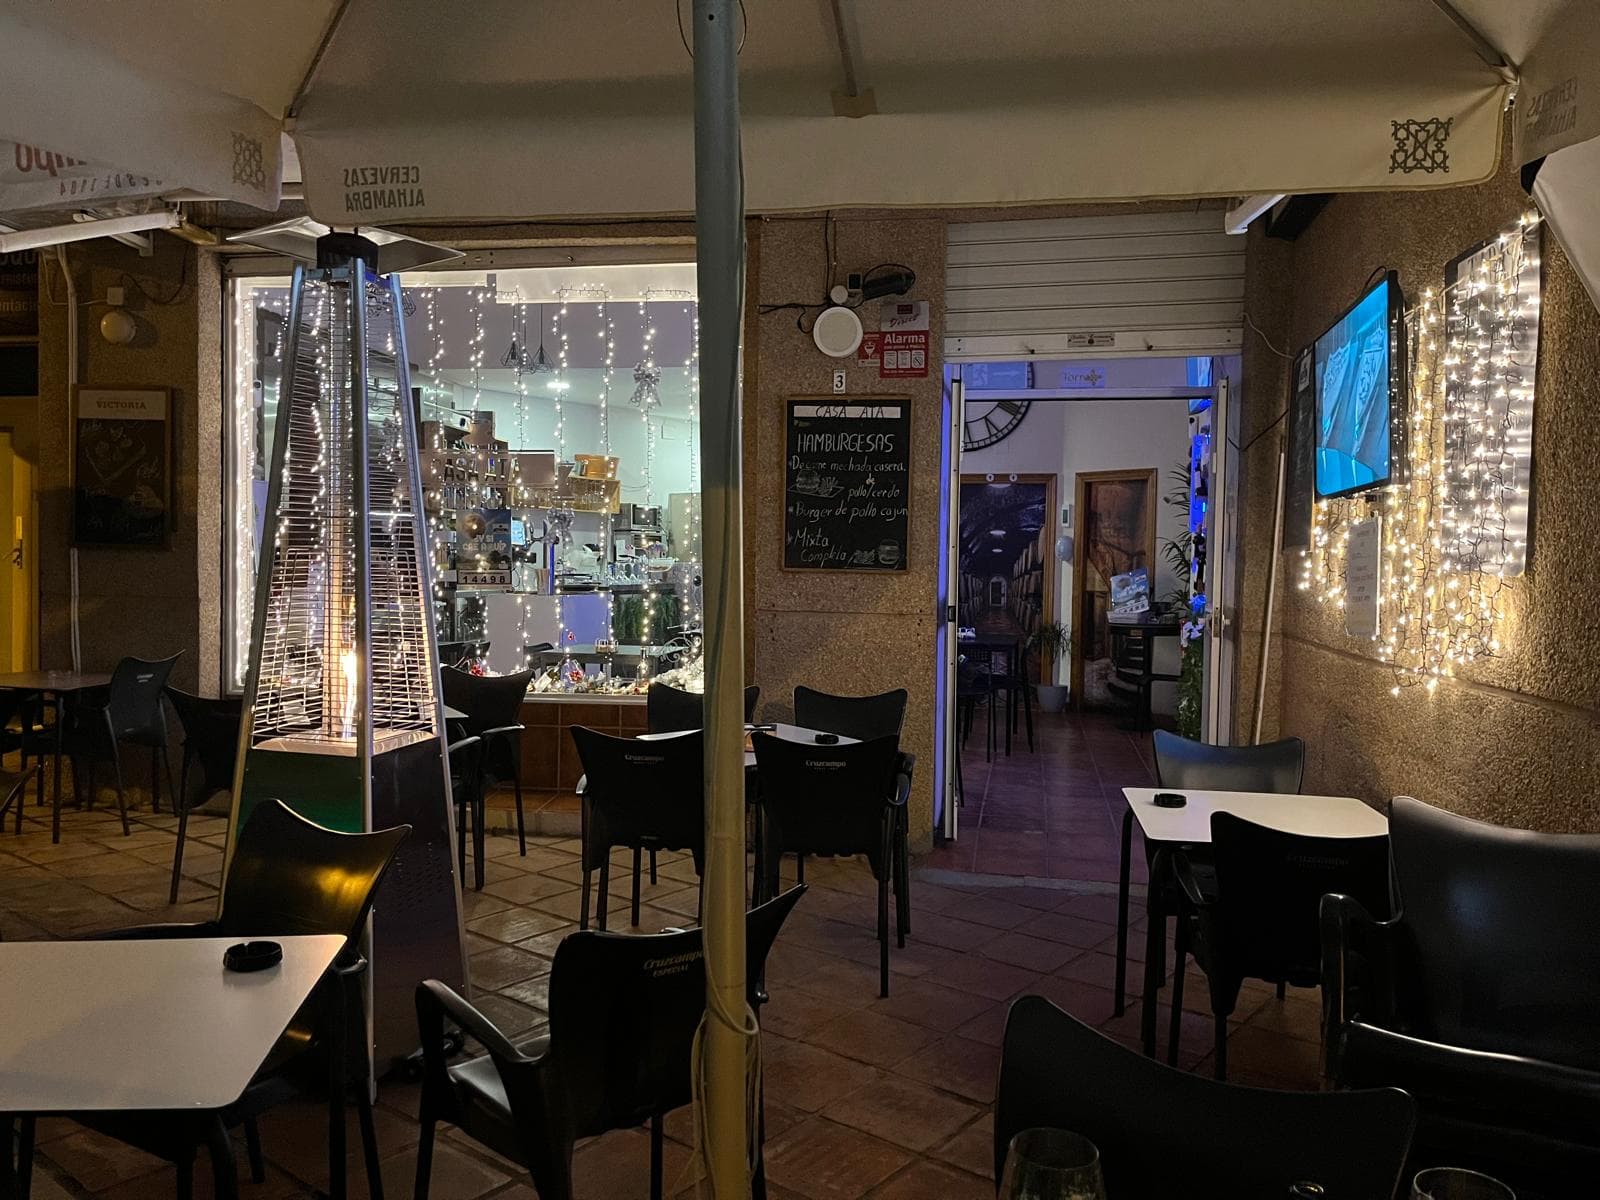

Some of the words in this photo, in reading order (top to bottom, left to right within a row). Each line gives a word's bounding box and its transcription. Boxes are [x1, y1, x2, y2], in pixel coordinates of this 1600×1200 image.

[884, 333, 925, 344] Alarma
[835, 374, 843, 388] 3
[96, 400, 147, 409] VICTORIA
[815, 405, 847, 418] CASA
[798, 433, 895, 453] HAMBURGESAS
[796, 502, 832, 523] Burger
[835, 501, 848, 516] de
[848, 503, 877, 524] pollo
[795, 527, 829, 548] Mixta
[805, 760, 847, 768] Cruzcampo
